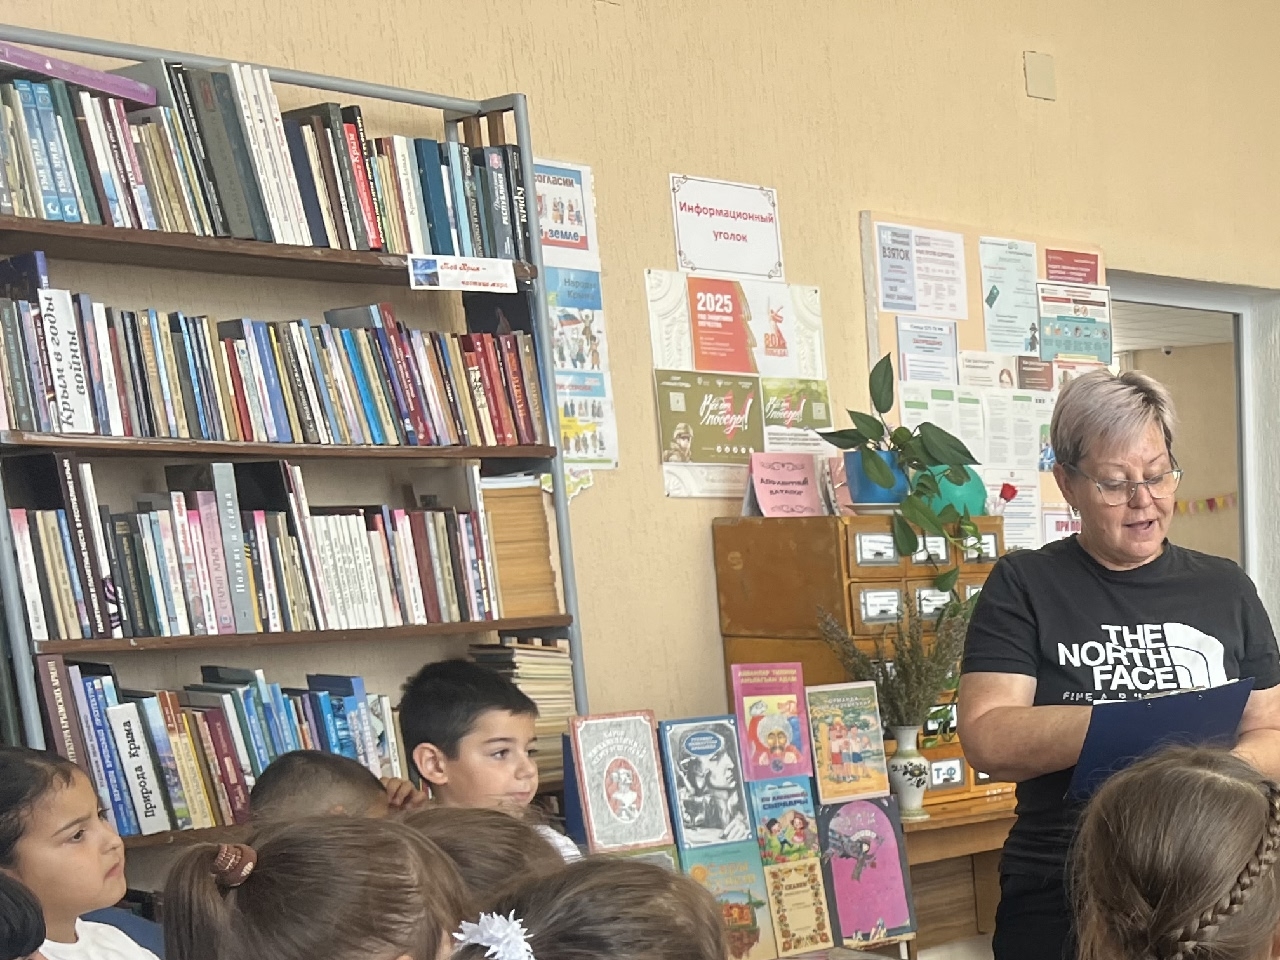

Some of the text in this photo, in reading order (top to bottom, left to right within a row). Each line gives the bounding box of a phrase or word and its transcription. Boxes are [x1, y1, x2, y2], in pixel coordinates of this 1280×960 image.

[679, 201, 774, 223] Информационный
[549, 229, 579, 241] земле
[713, 230, 748, 242] уголок
[882, 245, 910, 261] ВЗЯТОК
[697, 292, 733, 313] 2025
[44, 296, 61, 346] годы
[66, 330, 86, 395] войны
[57, 367, 74, 428] Крым
[1070, 520, 1081, 532] ПО
[77, 528, 87, 550] МЕСТА
[90, 592, 104, 633] ПАМЯТНИКИ
[1101, 624, 1166, 648] THE
[1057, 641, 1172, 668] NORTH
[1093, 665, 1178, 691] FACE
[121, 719, 158, 818] Природа Крыма
